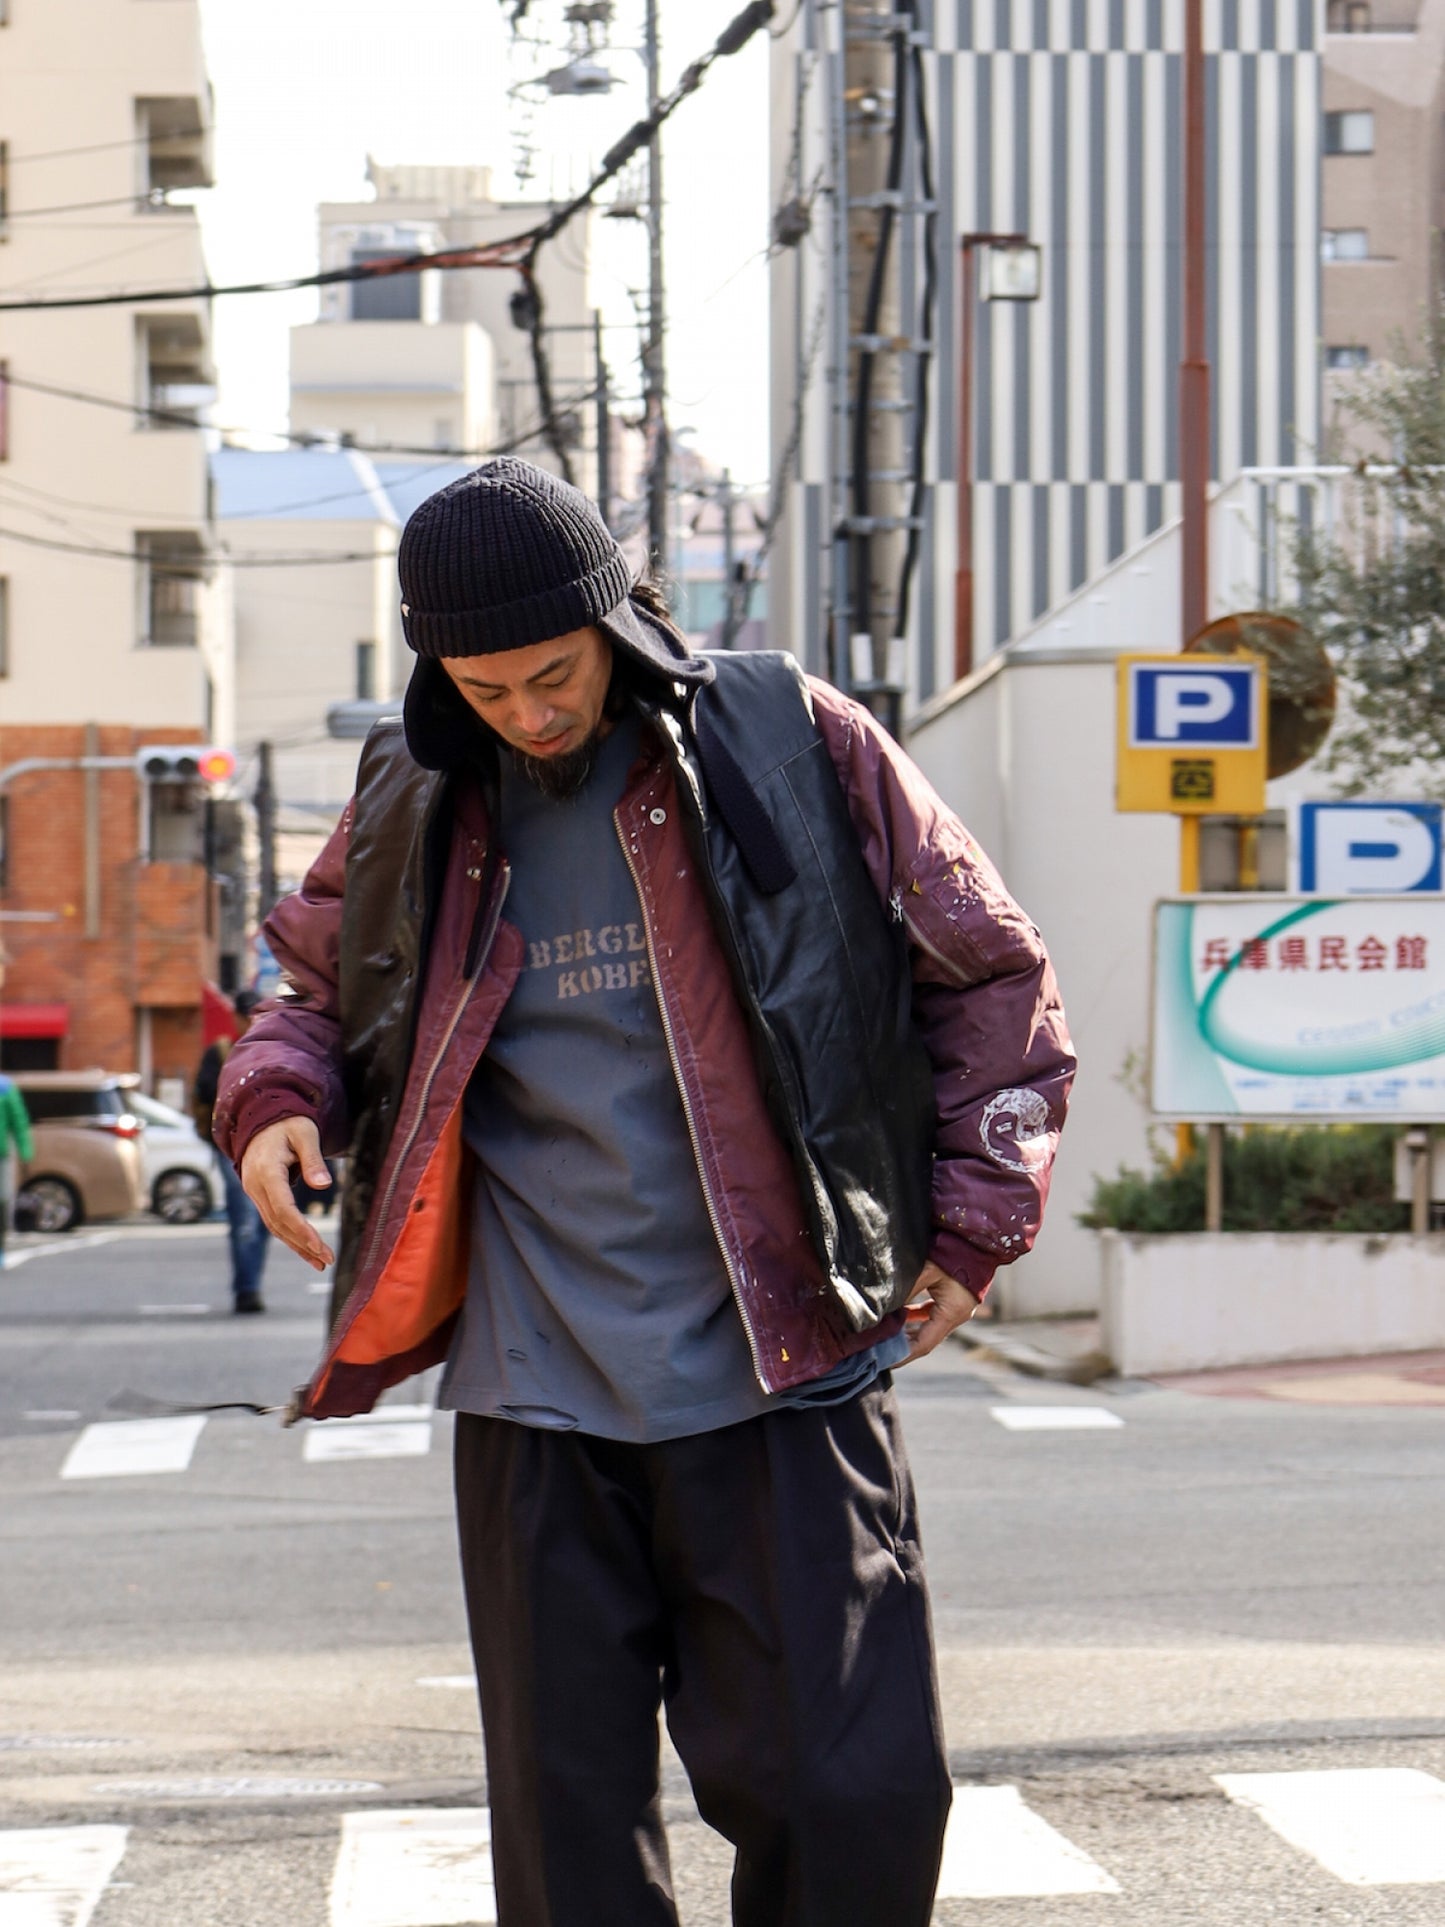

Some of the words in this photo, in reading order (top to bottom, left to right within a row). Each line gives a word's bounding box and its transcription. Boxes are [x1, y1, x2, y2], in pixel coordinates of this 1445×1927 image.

[1154, 675, 1235, 738] P
[1315, 808, 1434, 893] P
[522, 923, 647, 971] BERGL
[1201, 935, 1428, 973] 兵庫県民会館
